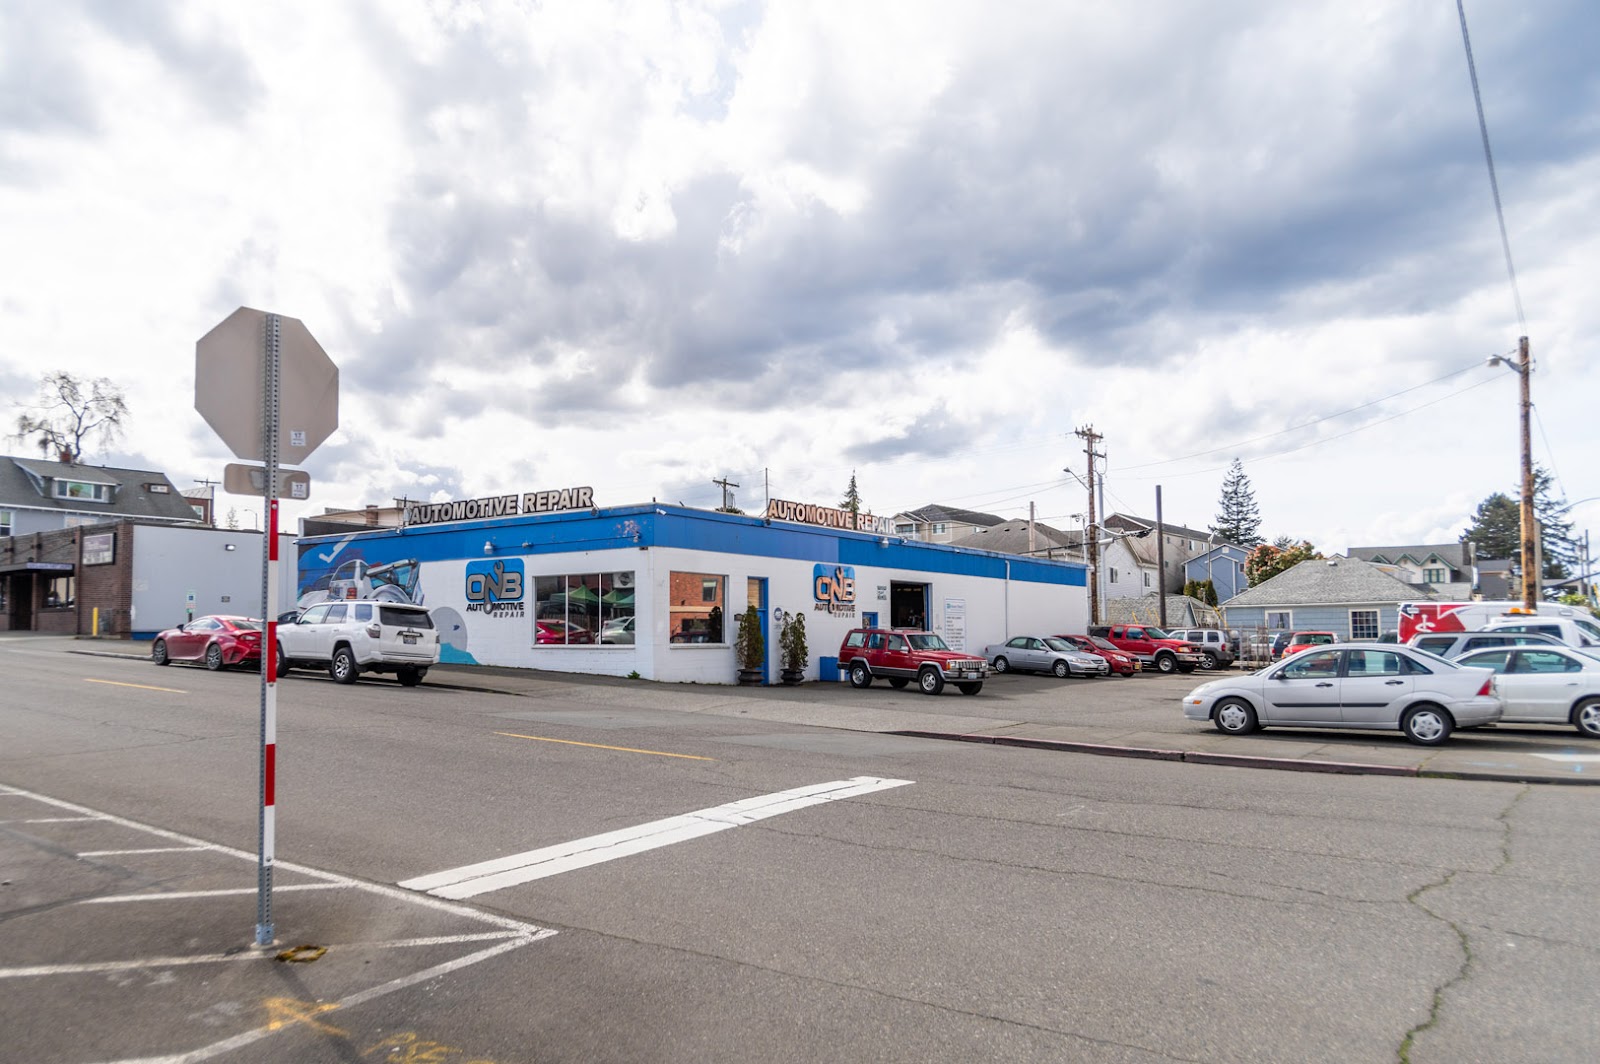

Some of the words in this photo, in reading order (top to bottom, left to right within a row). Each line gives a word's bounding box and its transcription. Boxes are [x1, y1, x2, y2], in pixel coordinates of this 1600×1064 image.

[408, 495, 518, 525] AUTOMOTIVE
[523, 486, 594, 513] REPAIR
[767, 499, 854, 529] AUTOMOTIVE
[857, 513, 897, 534] REPAIR
[466, 560, 523, 601] ONB
[815, 566, 856, 601] ONB
[466, 602, 524, 614] AUTOMOTIVE
